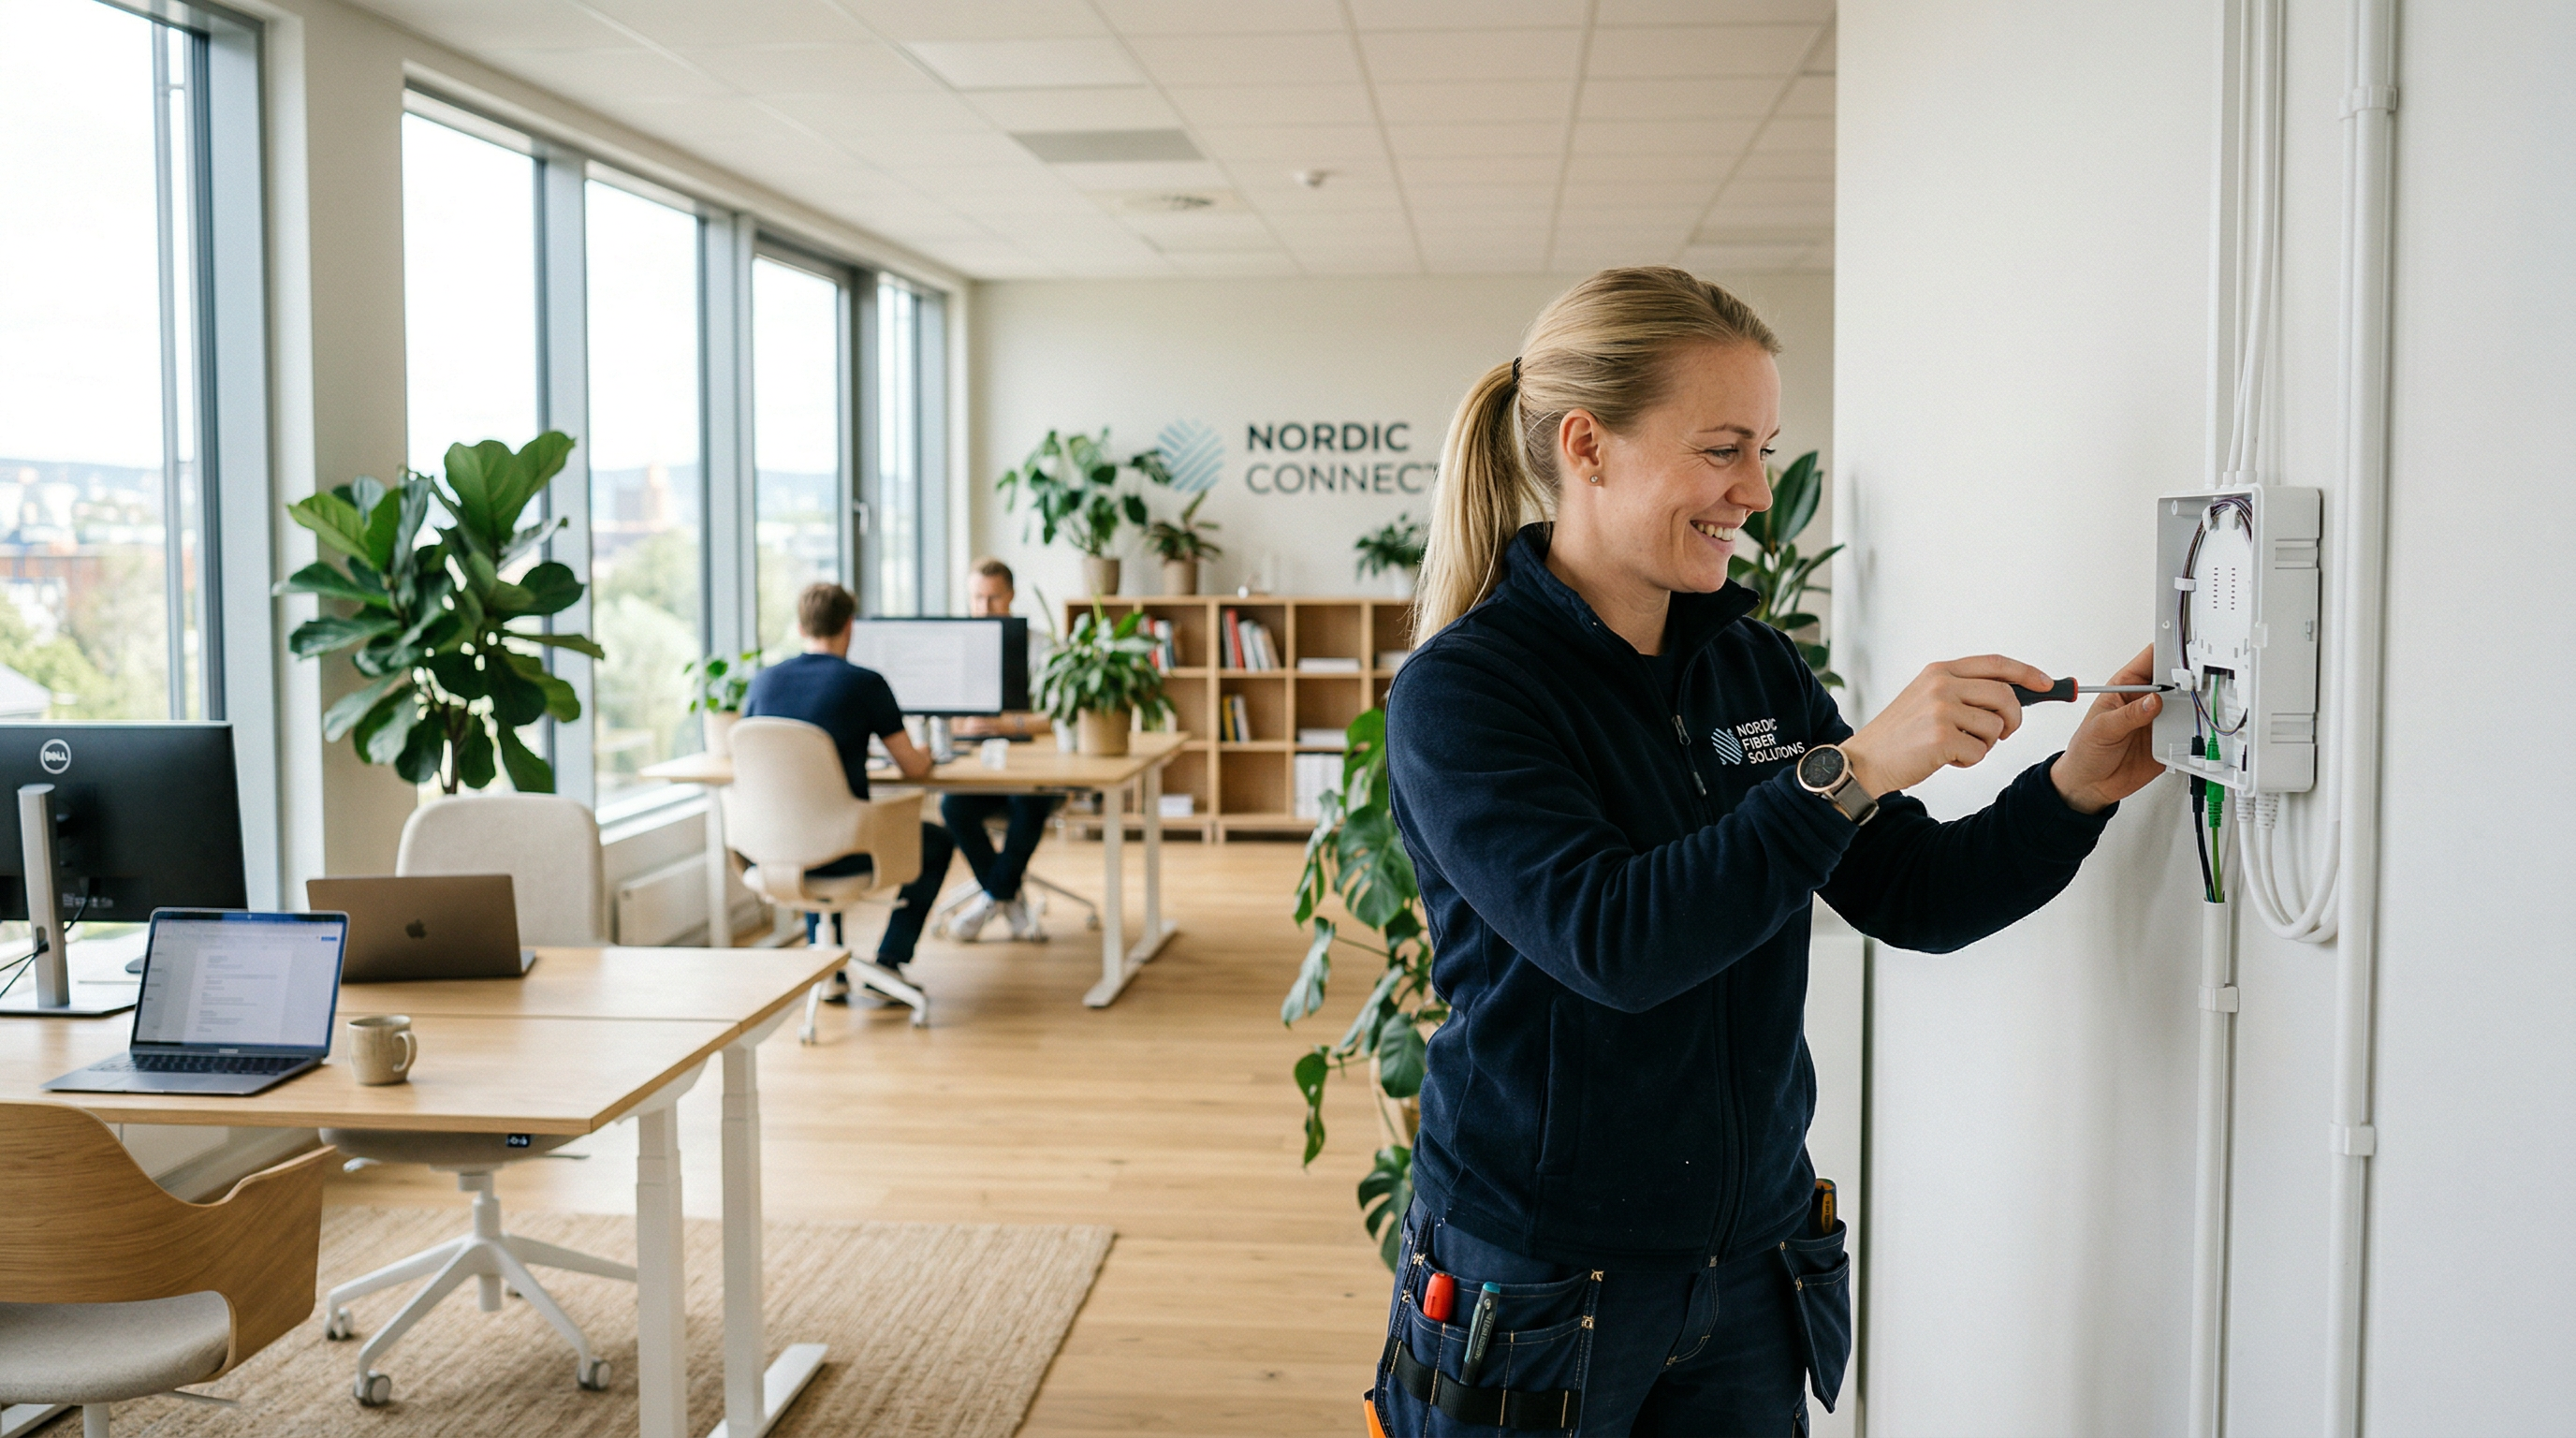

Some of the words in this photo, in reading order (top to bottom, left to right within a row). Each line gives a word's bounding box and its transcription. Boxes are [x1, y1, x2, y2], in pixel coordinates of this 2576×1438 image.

[1248, 423, 1410, 451] NORDIC
[1742, 733, 1777, 751] FIBER
[45, 751, 66, 761] DELL
[1748, 741, 1805, 764] SOLUTONS
